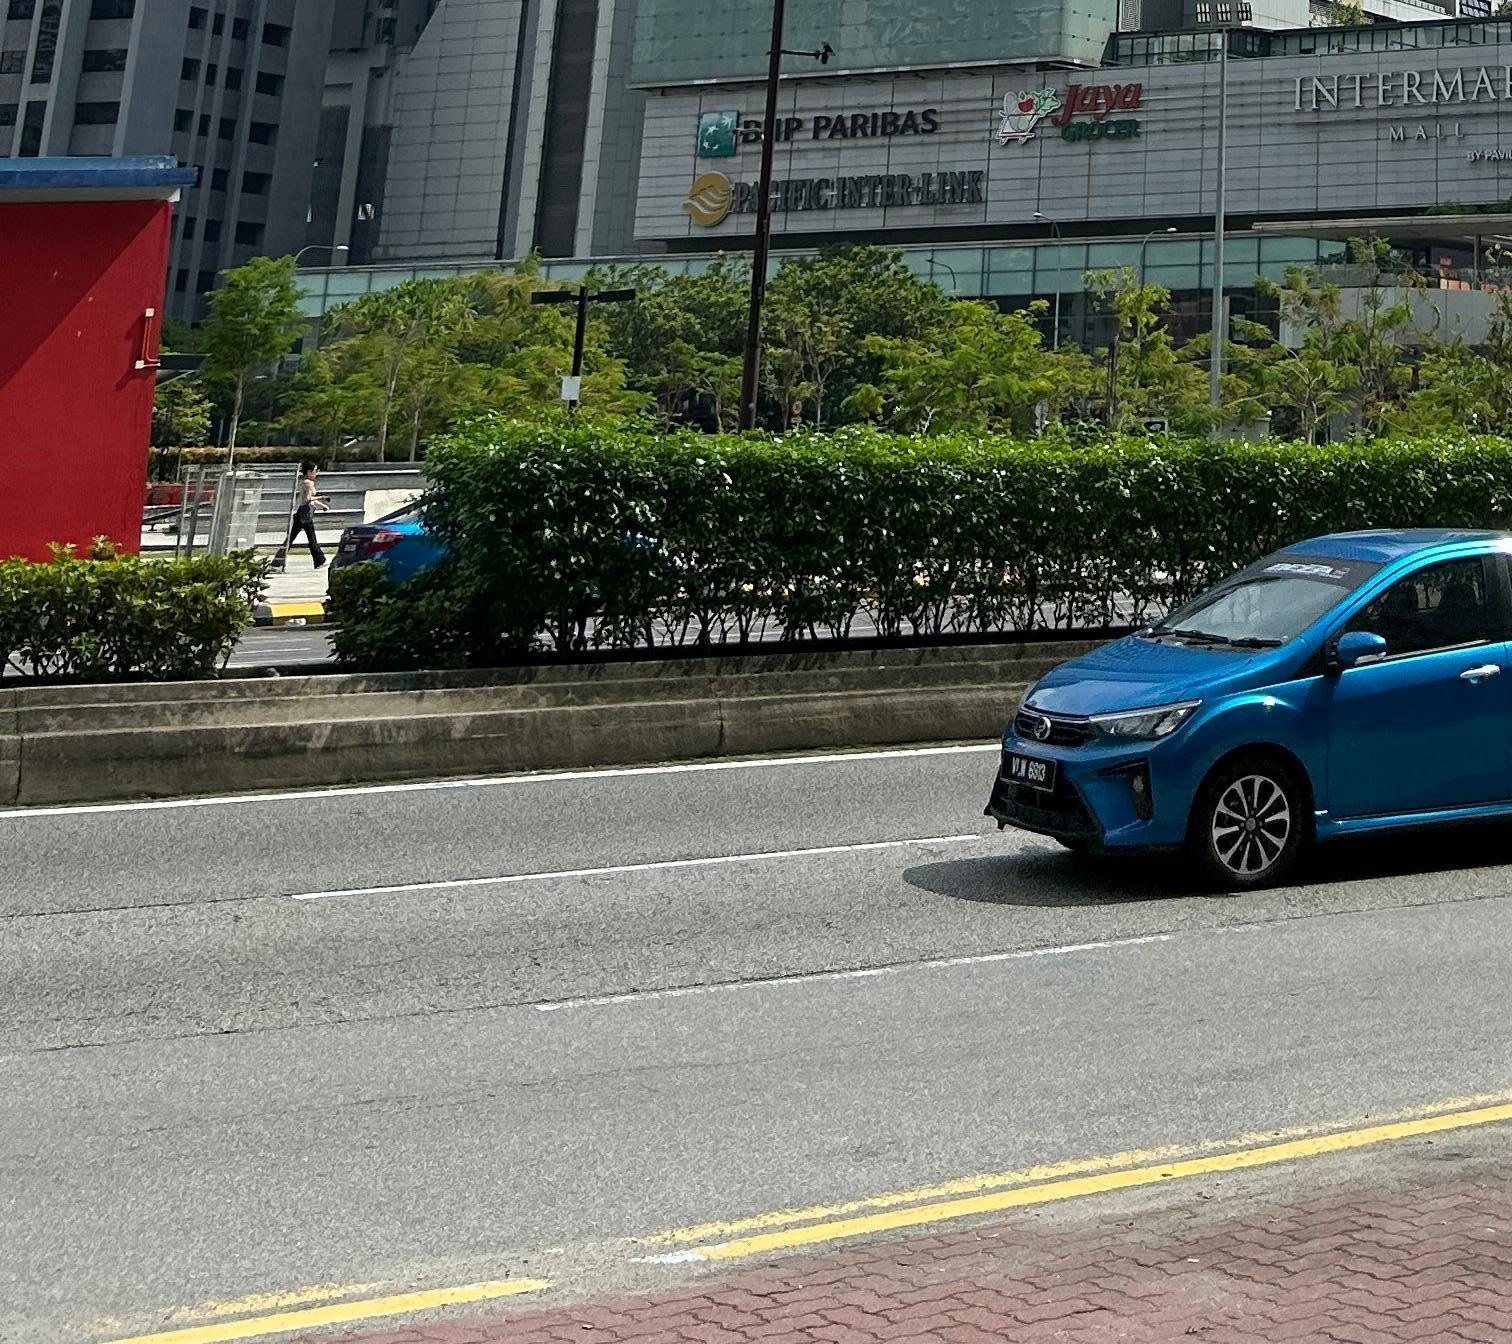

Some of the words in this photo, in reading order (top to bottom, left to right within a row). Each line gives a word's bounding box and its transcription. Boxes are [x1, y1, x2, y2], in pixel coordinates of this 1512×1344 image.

[1051, 83, 1143, 125] Jaya
[813, 108, 939, 140] PARIBAS
[1061, 119, 1141, 143] GROCER
[1389, 122, 1465, 142] MALL
[1466, 150, 1481, 162] BY
[836, 170, 984, 210] INTER-LINK
